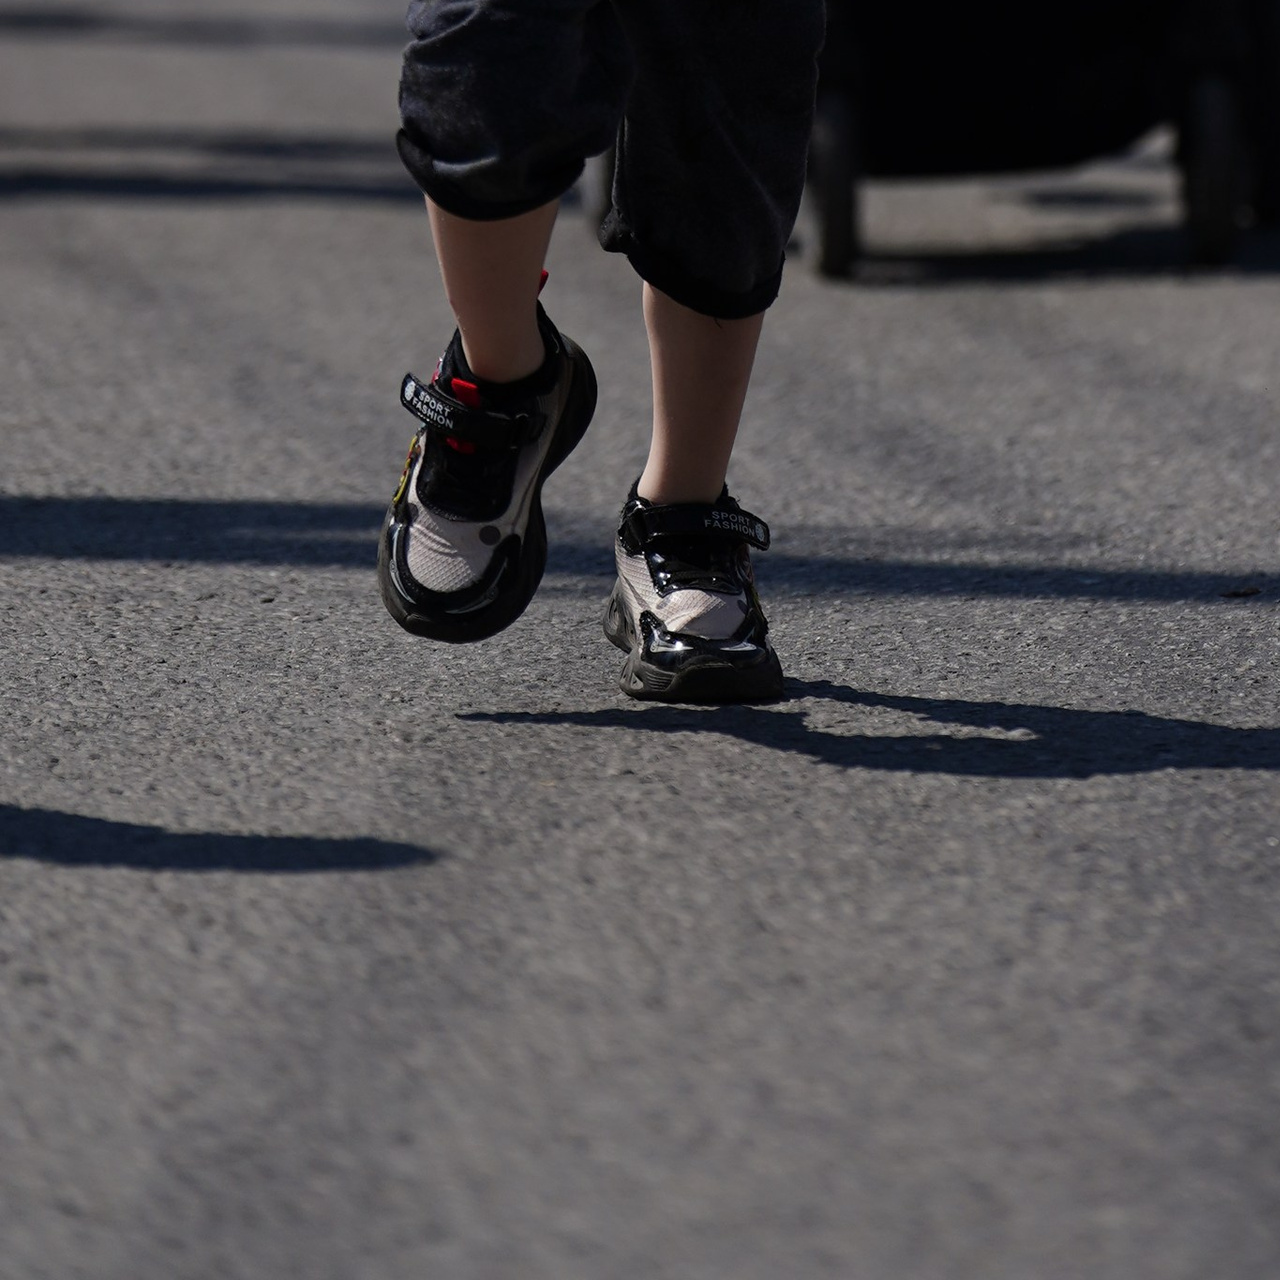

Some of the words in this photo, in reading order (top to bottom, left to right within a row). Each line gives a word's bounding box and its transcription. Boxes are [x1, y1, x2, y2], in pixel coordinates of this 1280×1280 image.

[412, 398, 454, 429] FASHION
[418, 391, 451, 417] SPORT
[704, 519, 755, 538] FASHION
[711, 510, 750, 526] SPORT
